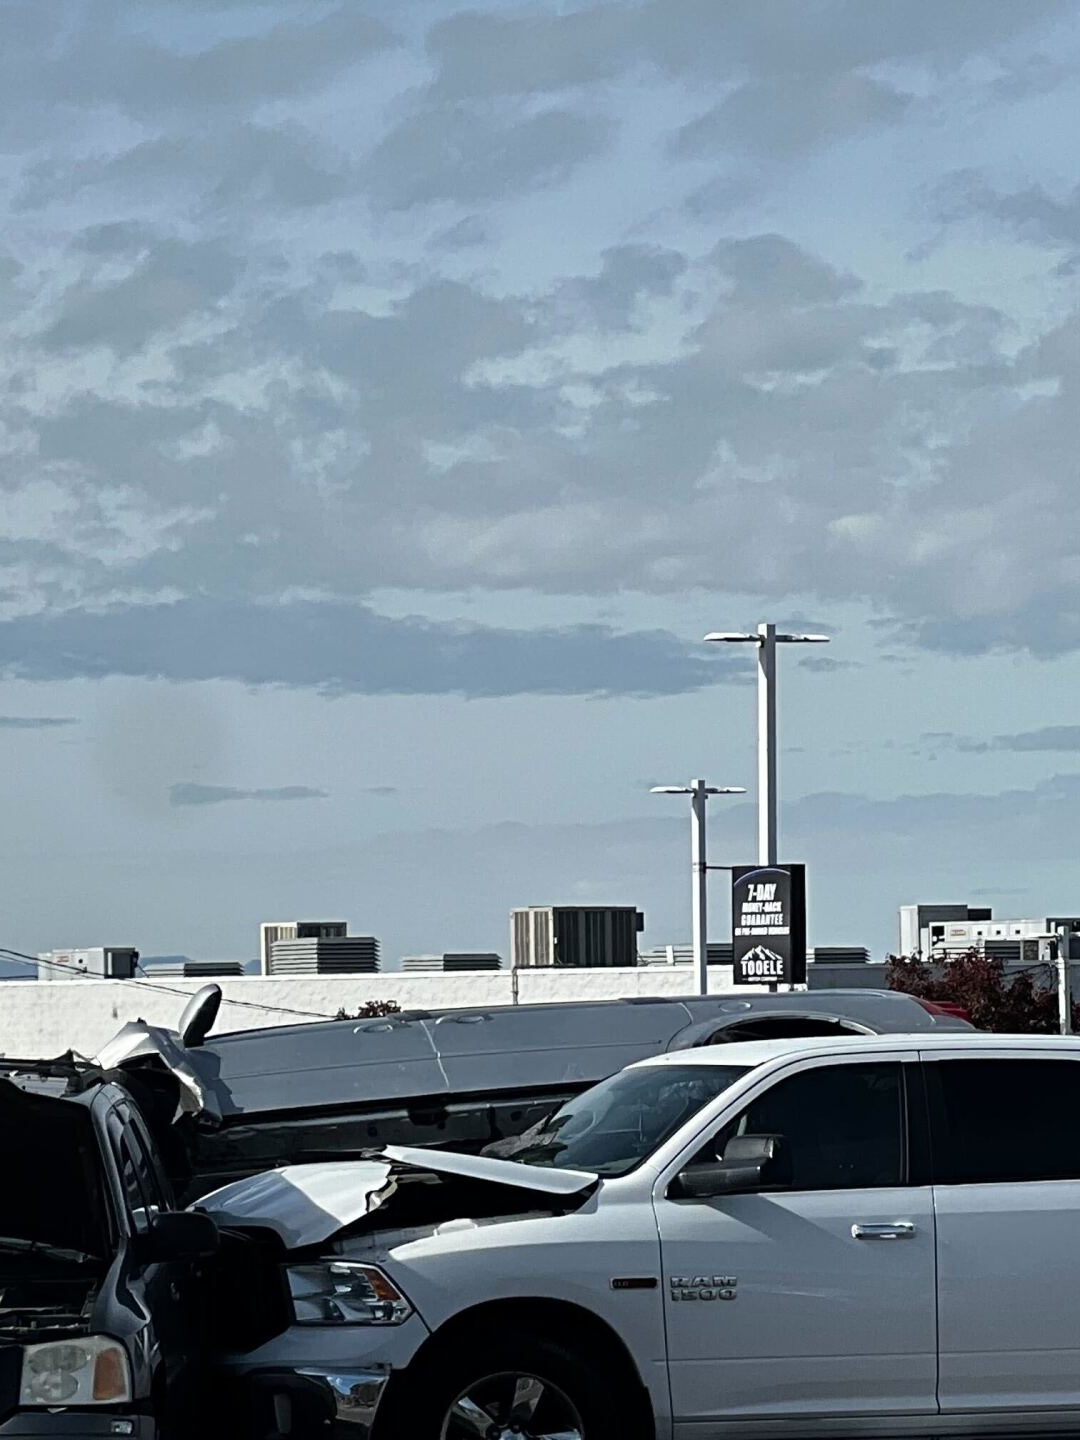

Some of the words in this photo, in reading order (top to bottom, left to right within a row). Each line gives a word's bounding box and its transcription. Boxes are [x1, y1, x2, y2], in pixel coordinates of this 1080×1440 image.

[747, 883, 777, 901] 7-DAY
[740, 913, 783, 926] GUARANTEE
[740, 960, 784, 975] TOOELE
[670, 1276, 737, 1288] RAM
[670, 1288, 737, 1301] 1500
